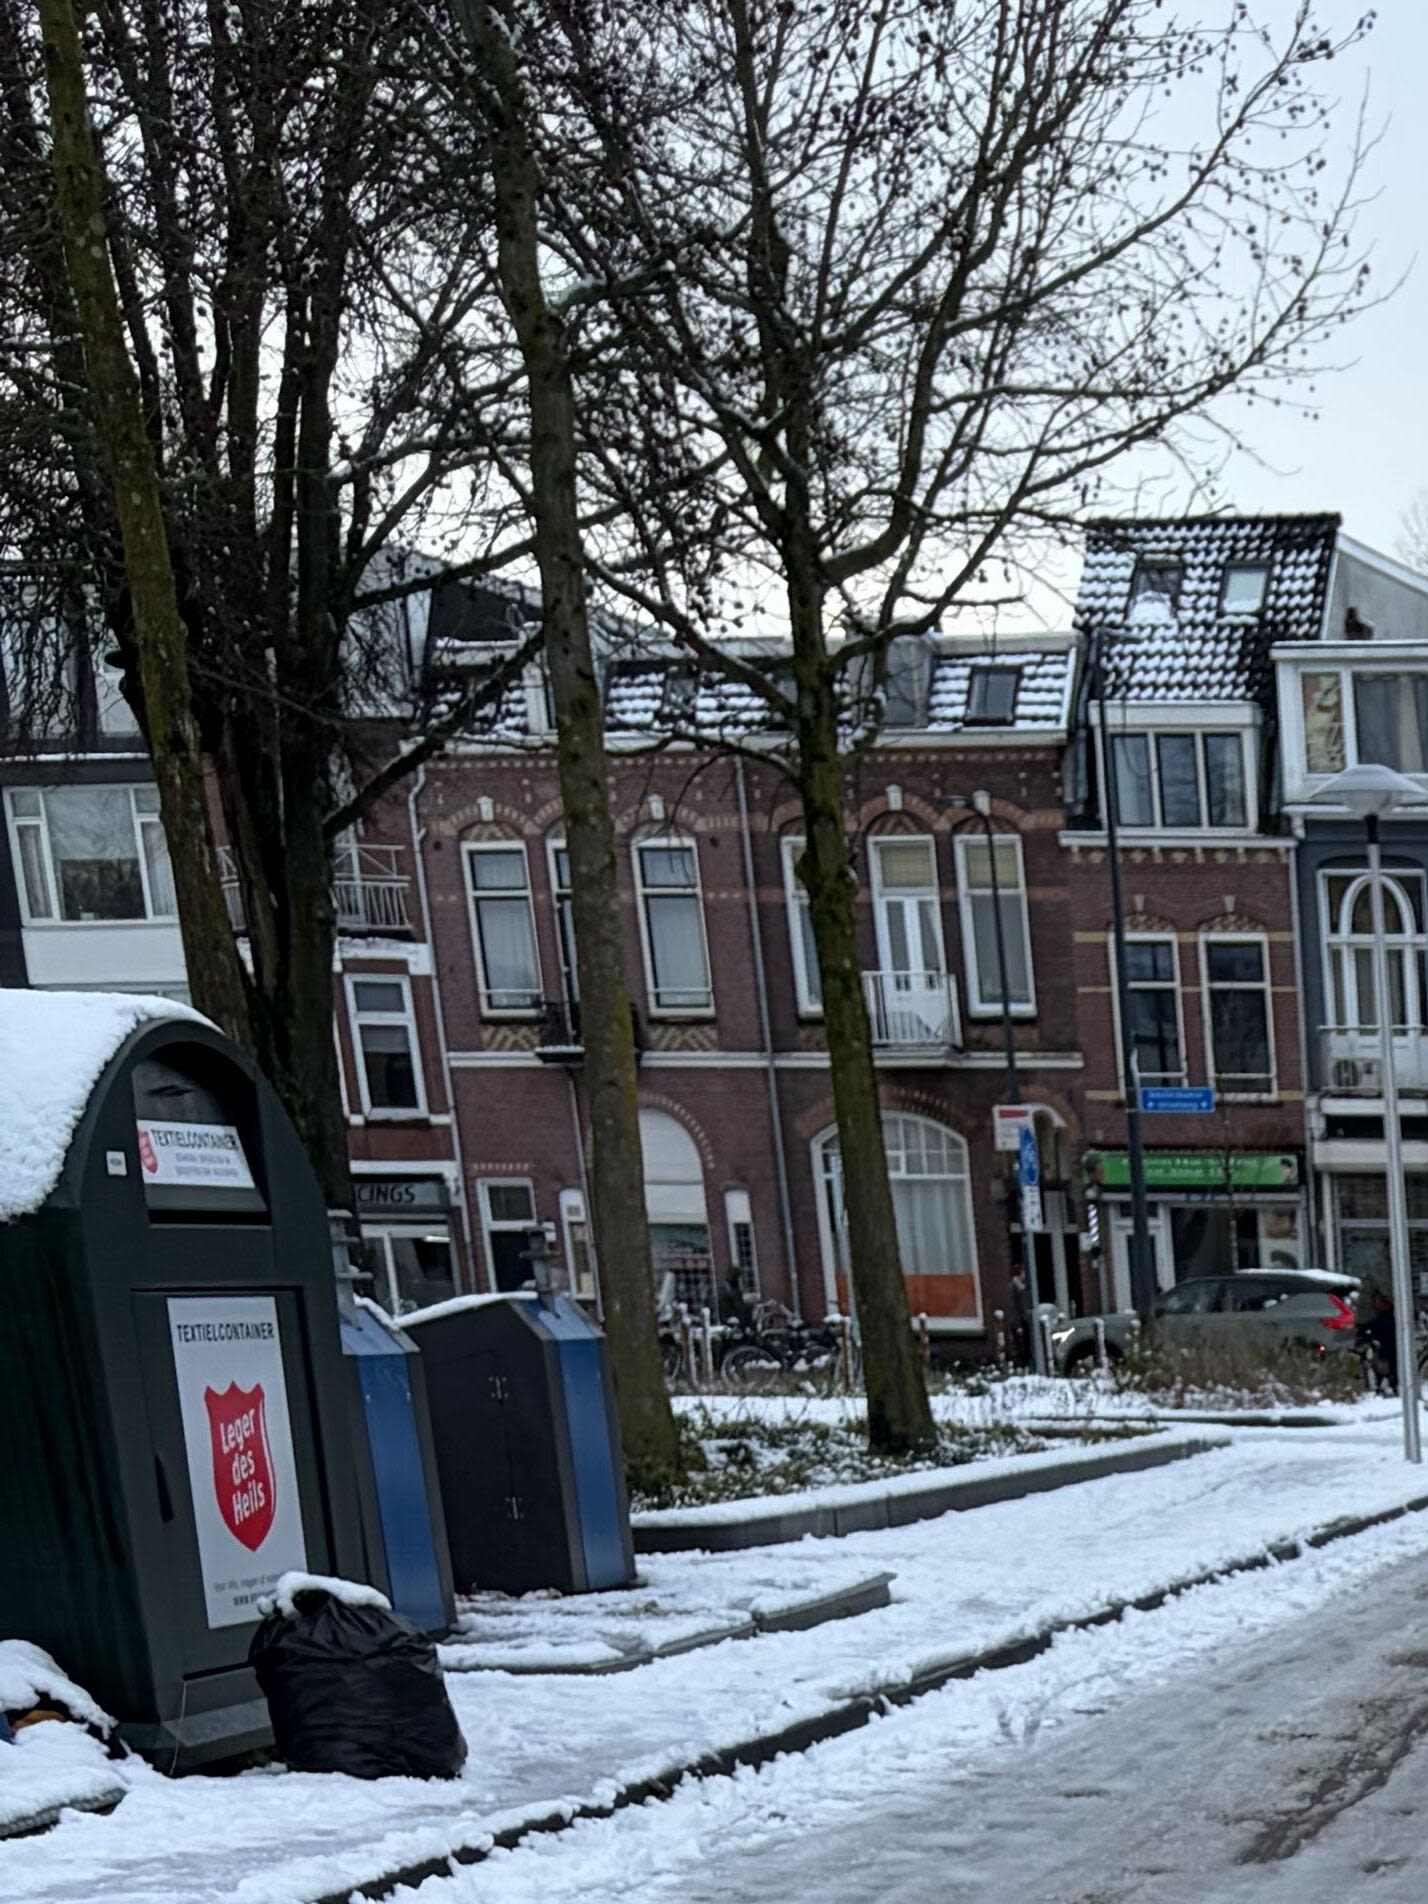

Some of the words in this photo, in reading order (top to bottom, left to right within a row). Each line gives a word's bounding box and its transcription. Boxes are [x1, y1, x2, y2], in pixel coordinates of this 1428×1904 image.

[151, 1129, 239, 1150] TEXTIELCONTAINER
[358, 1185, 415, 1203] CINGS
[177, 1323, 274, 1343] TEXTIELCONTAINER
[220, 1408, 256, 1454] Leger
[232, 1449, 255, 1485] des
[232, 1481, 265, 1526] Heils
